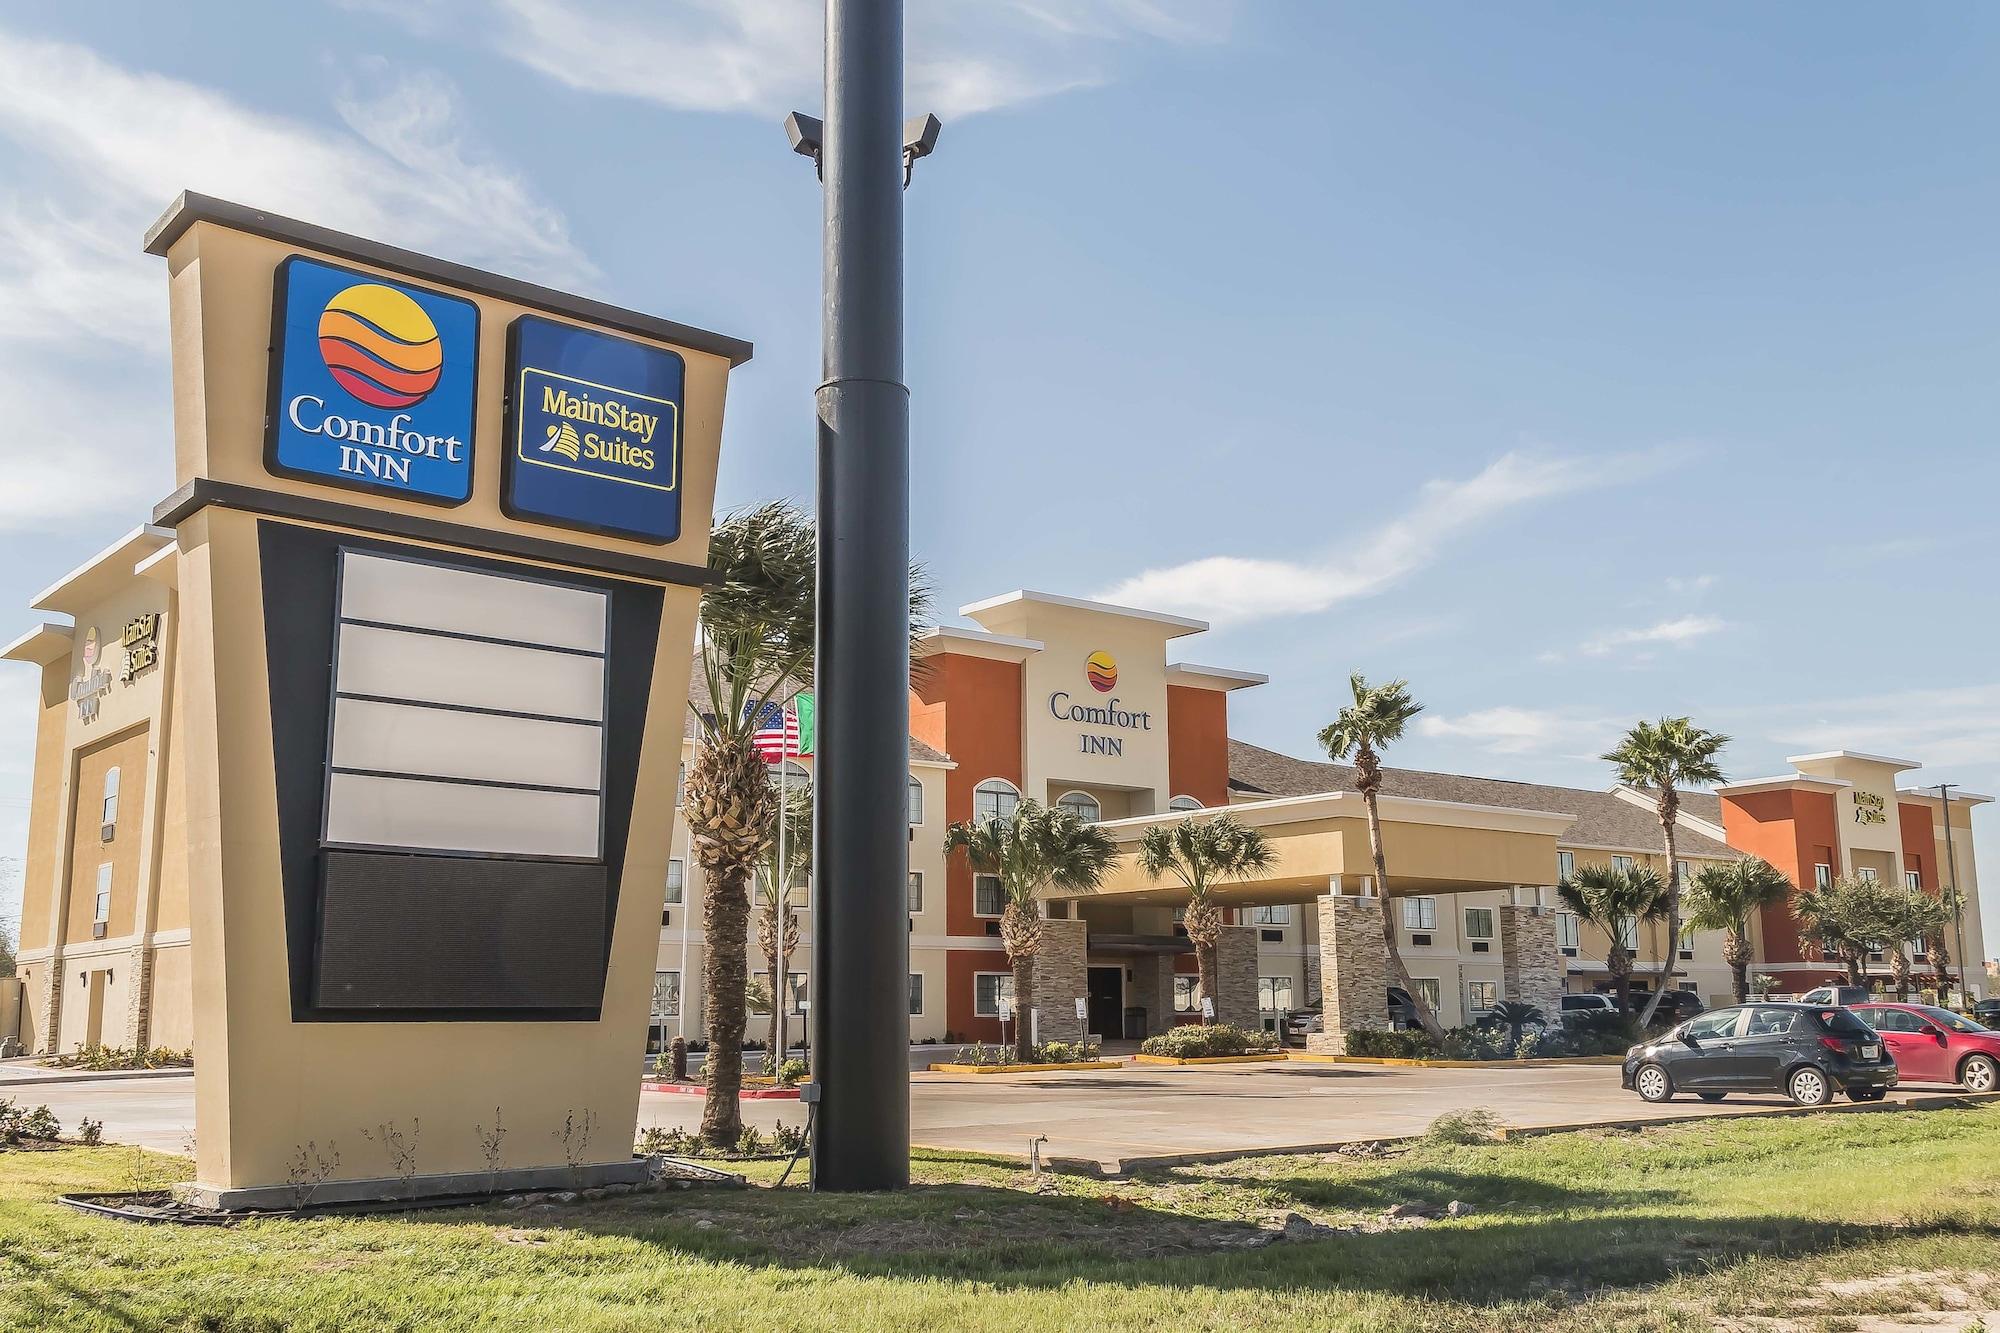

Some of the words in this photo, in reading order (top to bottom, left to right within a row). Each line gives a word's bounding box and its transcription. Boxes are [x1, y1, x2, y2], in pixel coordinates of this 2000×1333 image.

[288, 394, 464, 463] Comfort
[542, 386, 658, 444] MainStay
[338, 445, 412, 484] INN
[583, 433, 656, 471] Suites
[1050, 692, 1151, 731] Comfort
[1081, 734, 1123, 757] INN
